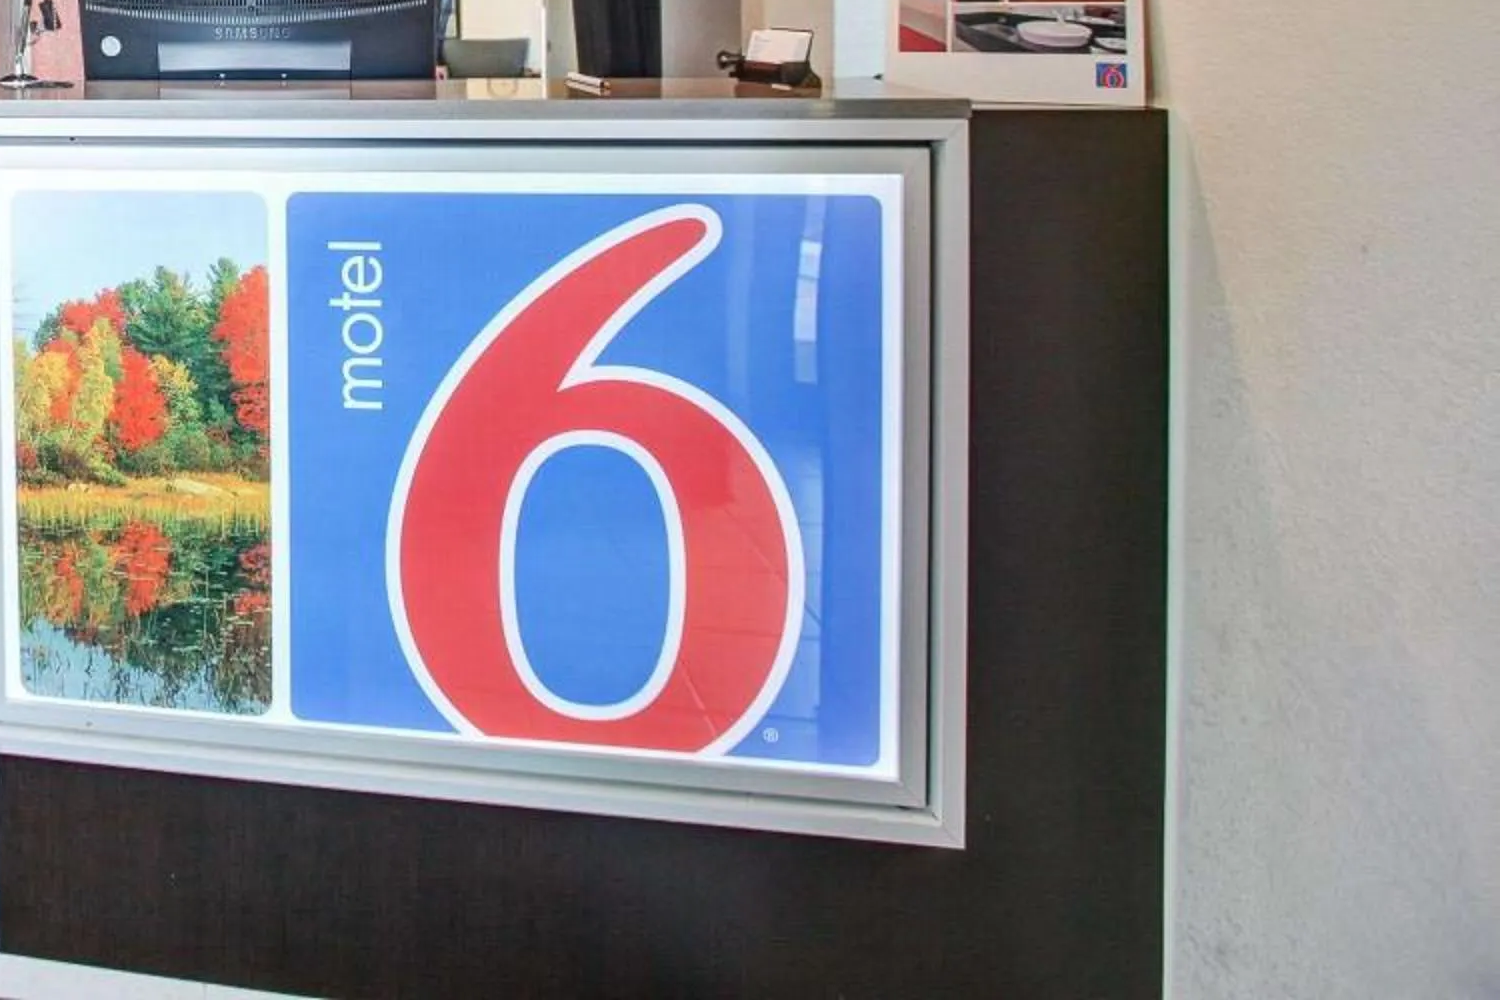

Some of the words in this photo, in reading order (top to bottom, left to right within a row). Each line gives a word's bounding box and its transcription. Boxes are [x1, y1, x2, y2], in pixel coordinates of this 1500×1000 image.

[214, 26, 291, 40] SAMSUNG
[327, 240, 383, 410] motel
[386, 203, 806, 758] 6
